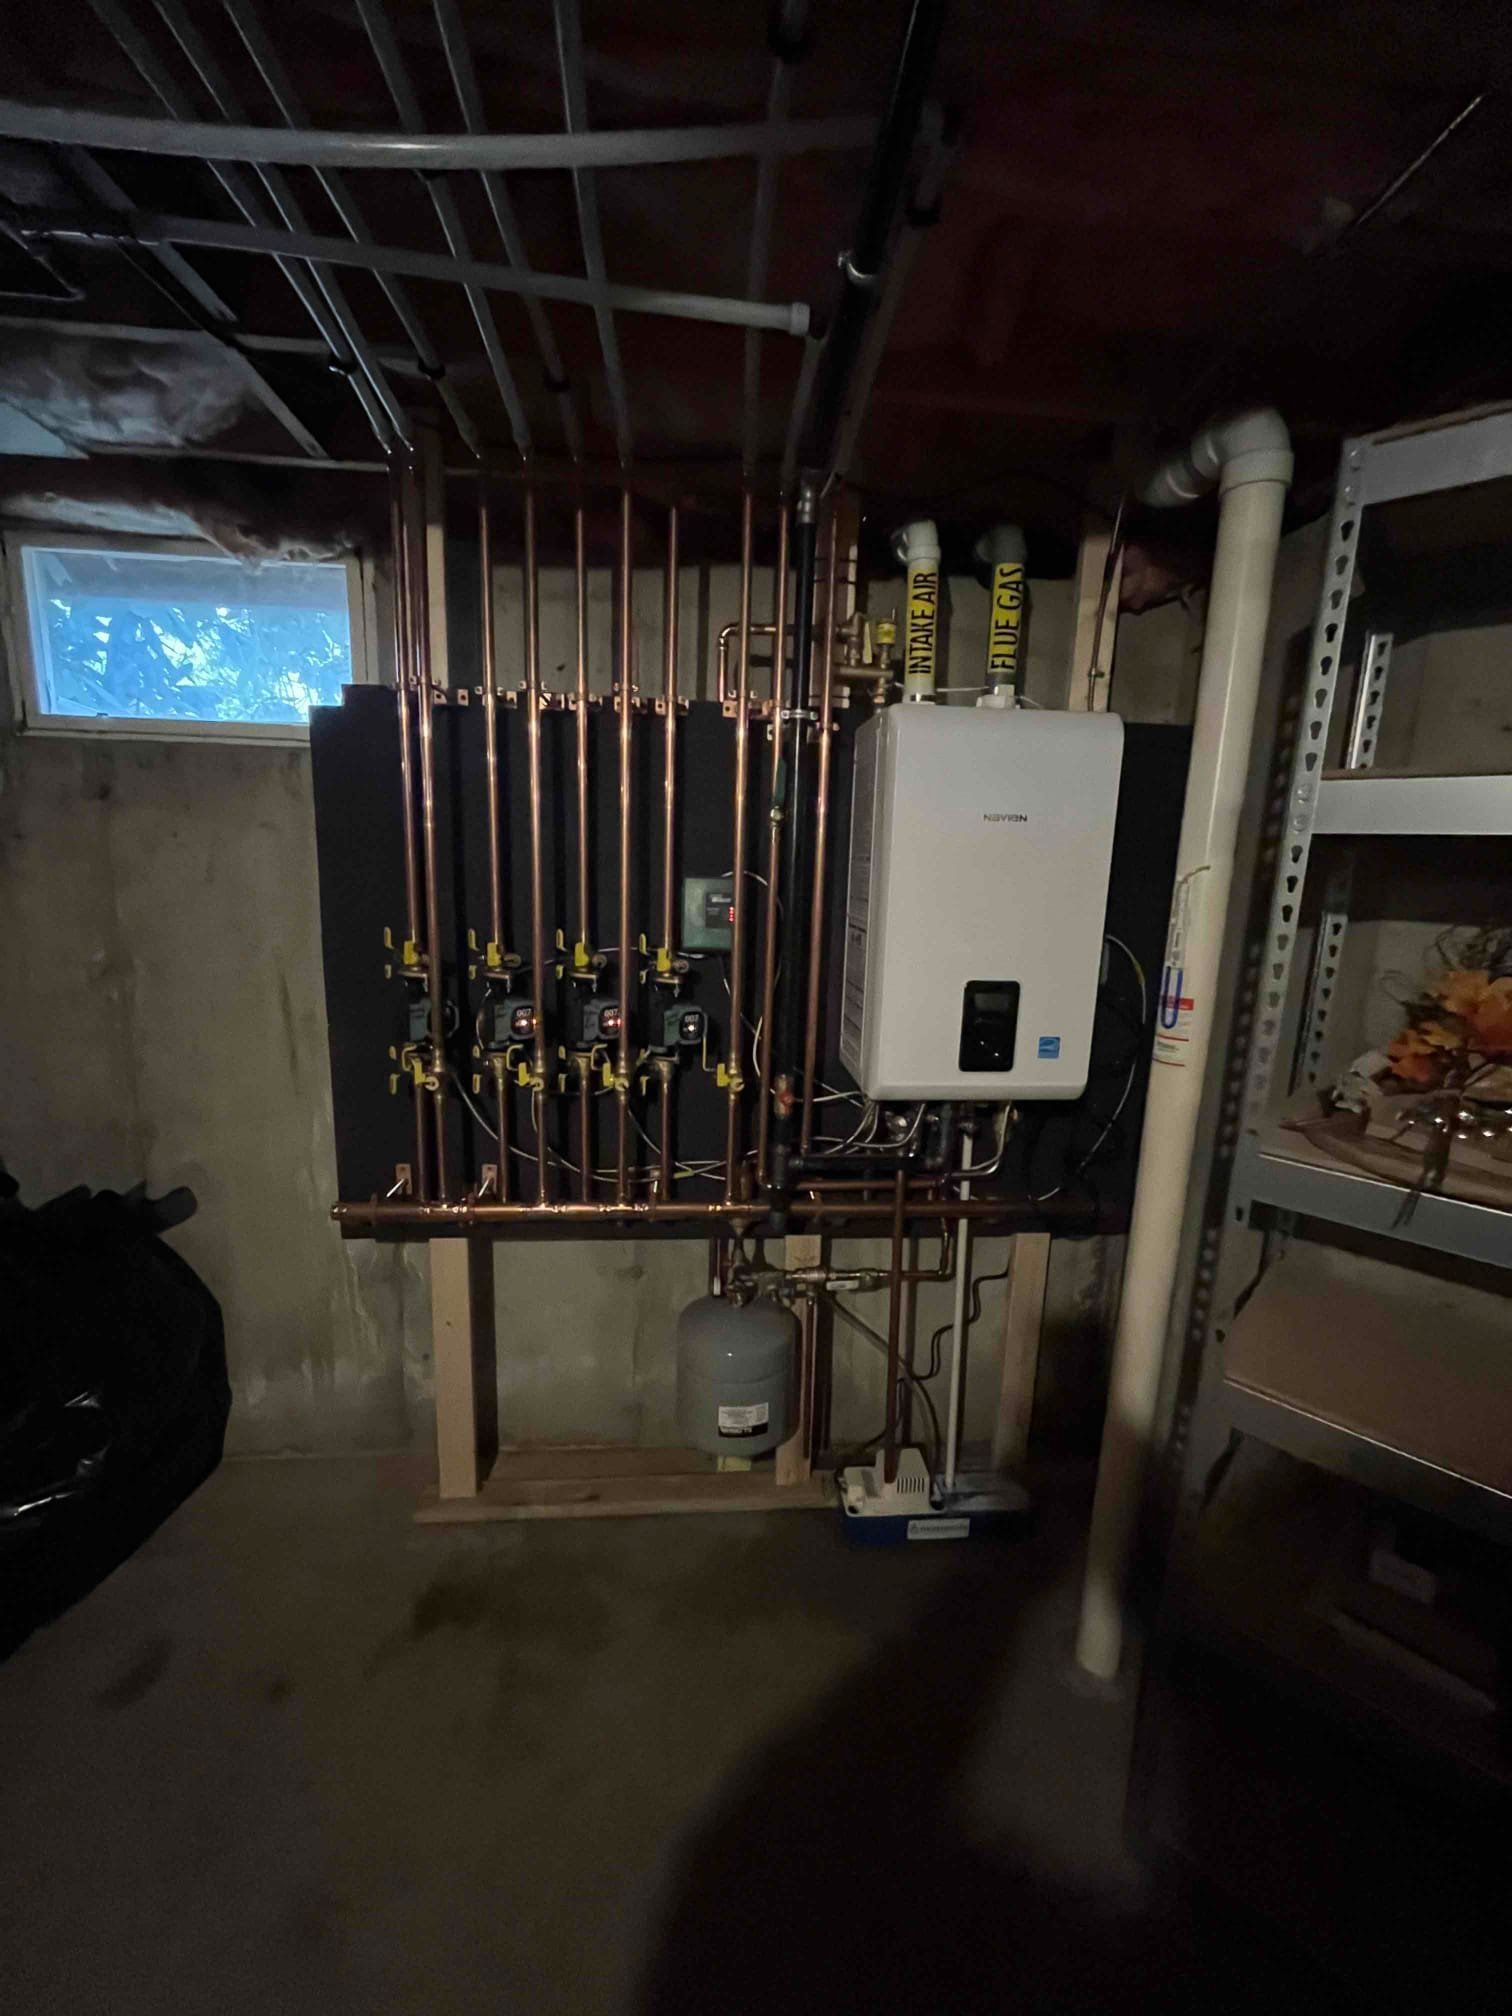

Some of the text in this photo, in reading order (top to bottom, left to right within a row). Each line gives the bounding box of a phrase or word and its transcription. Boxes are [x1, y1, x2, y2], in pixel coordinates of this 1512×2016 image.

[908, 572, 937, 674] INTAKE AIR
[990, 567, 1024, 670] FLUE GAS
